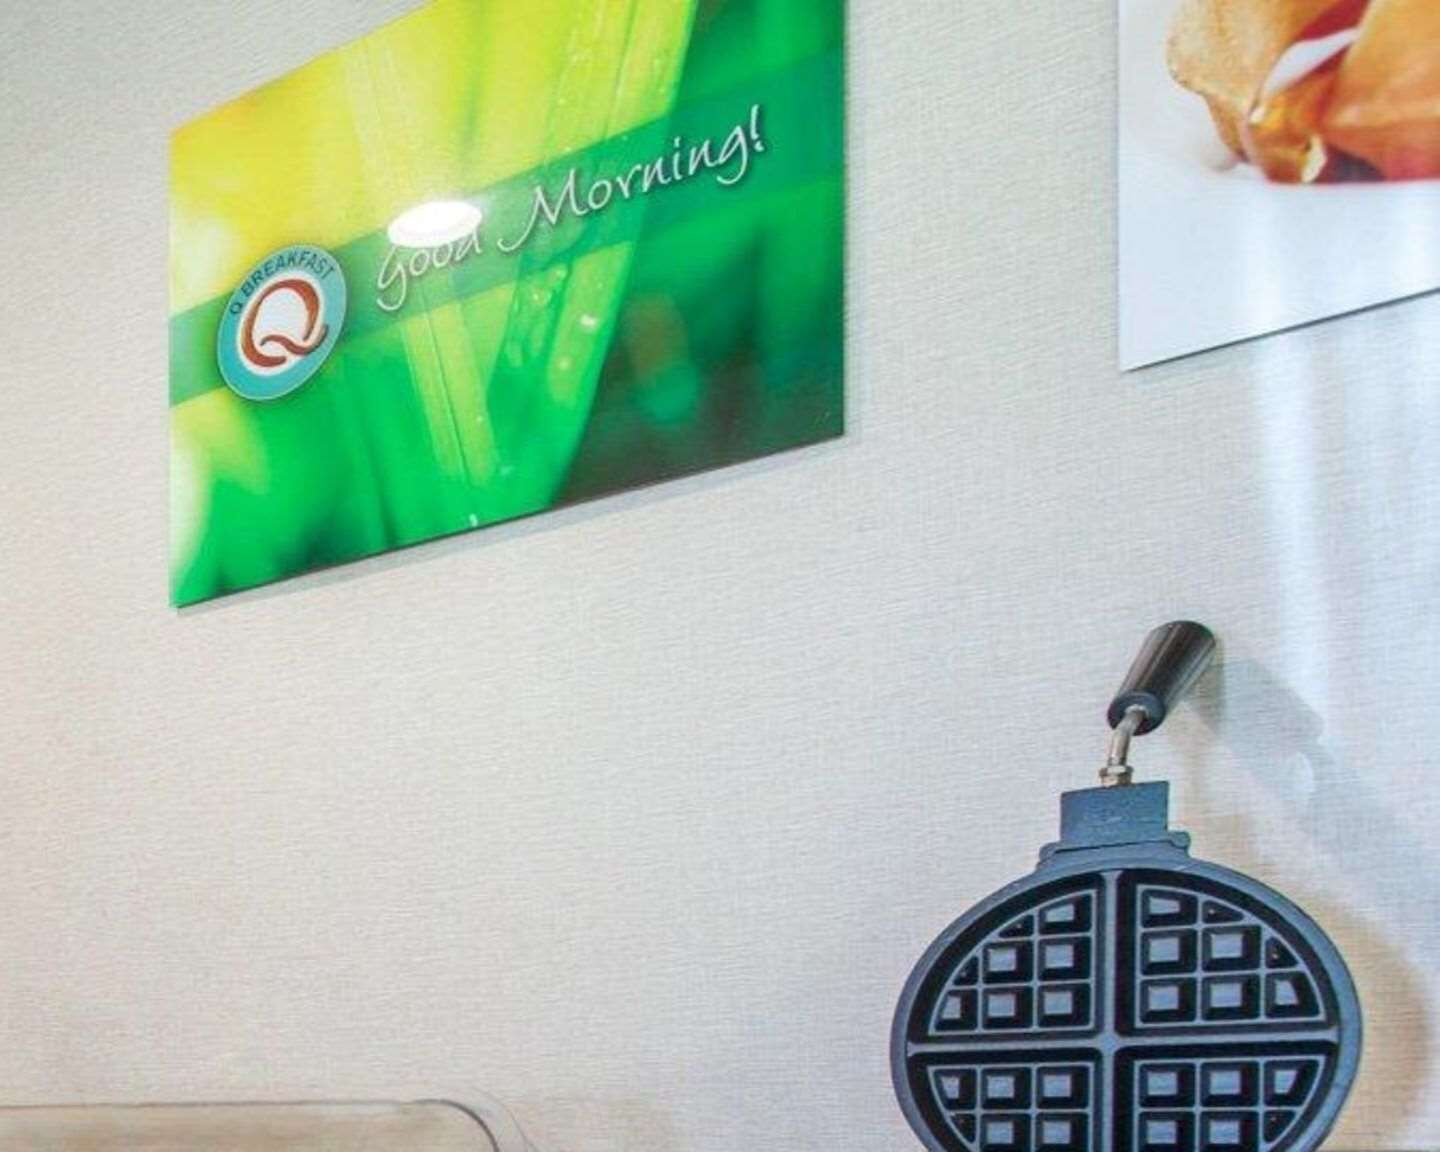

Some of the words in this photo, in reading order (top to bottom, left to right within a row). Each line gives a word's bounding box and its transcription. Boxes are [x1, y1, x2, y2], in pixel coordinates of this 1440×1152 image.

[497, 103, 765, 253] Morning!
[240, 249, 335, 299] BREAKFAST
[240, 278, 330, 368] Q
